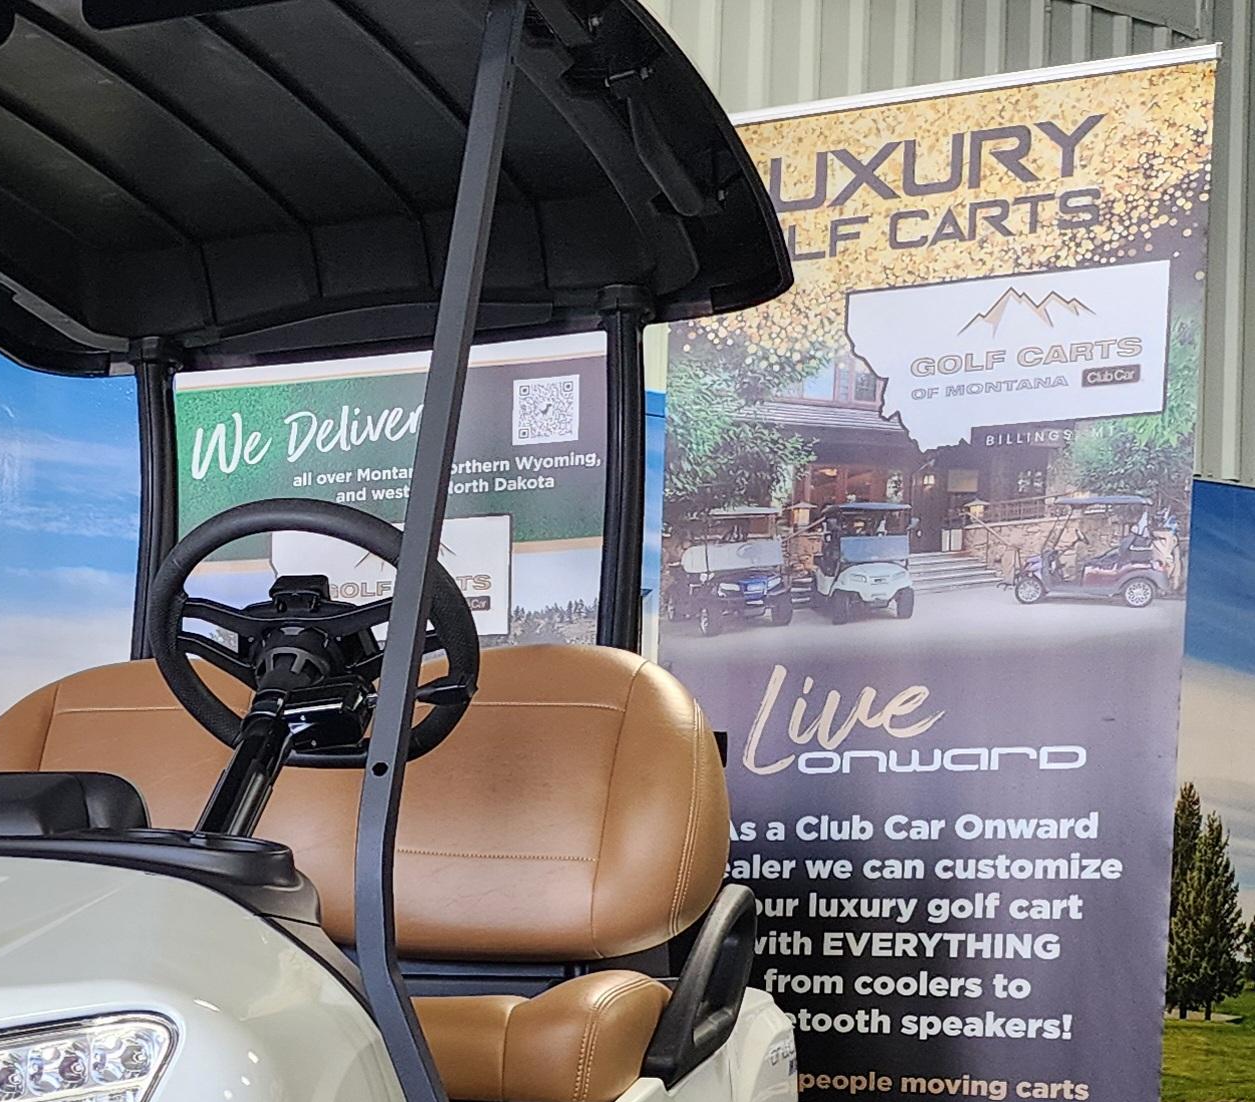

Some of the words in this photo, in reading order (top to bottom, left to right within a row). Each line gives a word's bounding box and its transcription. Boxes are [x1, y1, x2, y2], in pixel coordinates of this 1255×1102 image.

[769, 113, 1107, 214] UXURY
[788, 215, 870, 262] LF
[889, 187, 1102, 251] CARTS
[910, 350, 1007, 378] GOLF
[1016, 336, 1143, 367] CARTS
[911, 386, 940, 401] OF
[945, 375, 1069, 397] MONTANA
[1086, 371, 1114, 385] Club
[1114, 368, 1137, 382] Car
[190, 412, 273, 480] We
[292, 471, 314, 487] all
[317, 471, 353, 485] over
[357, 466, 414, 482] Monta
[450, 459, 510, 475] orthern
[514, 450, 602, 472] Wyoming,
[336, 487, 367, 503] and
[372, 484, 410, 500] west
[494, 474, 555, 491] Dakota
[743, 664, 946, 776] Live
[766, 821, 786, 841] a
[795, 813, 874, 841] Club
[884, 813, 946, 841] Car
[955, 811, 1099, 841] Onward
[723, 853, 797, 879] aler
[804, 858, 853, 879] we
[862, 858, 925, 879] can
[934, 852, 1124, 880] customize
[808, 892, 918, 924] luxury
[926, 892, 1000, 923] golf
[1008, 893, 1084, 920] cart
[823, 932, 1062, 960] EVERYTHING
[764, 968, 844, 995] from
[853, 971, 983, 998] coolers
[992, 973, 1032, 999] to
[900, 1011, 1074, 1040] speakers!
[798, 1071, 893, 1095] people
[900, 1075, 1008, 1101] moving
[1015, 1080, 1090, 1101] carts
